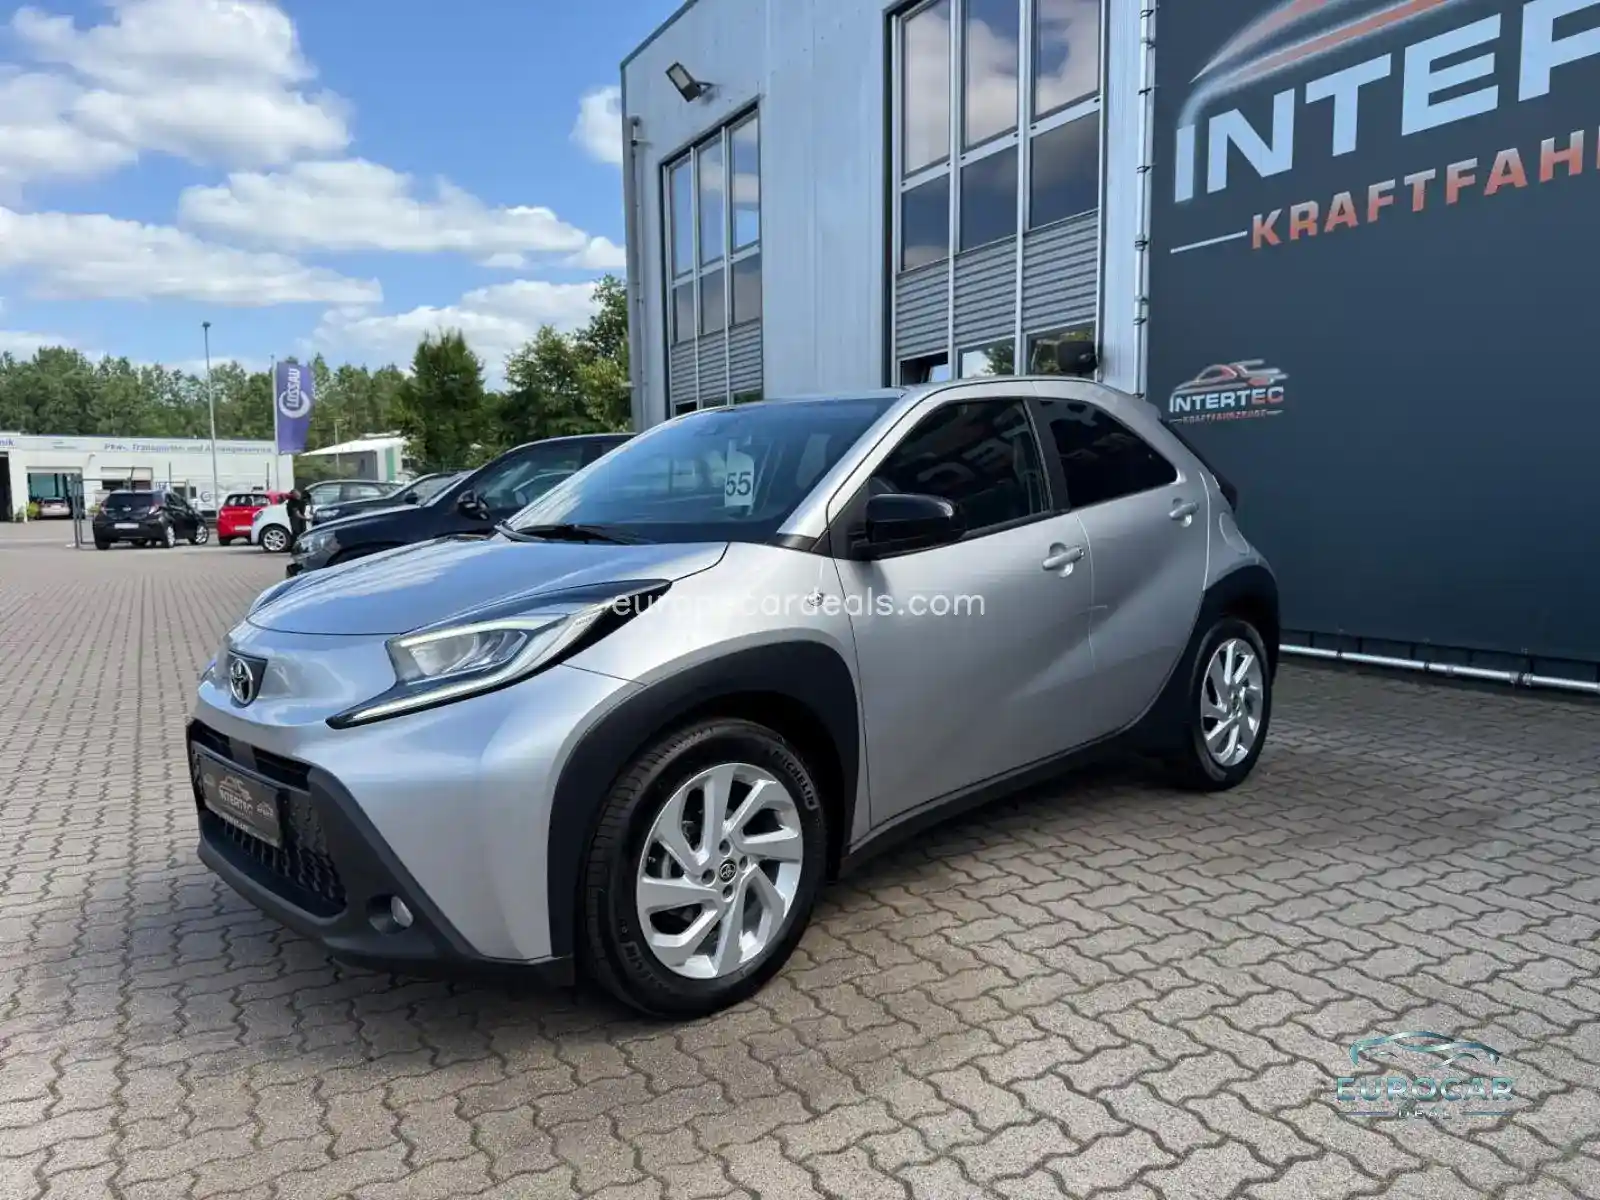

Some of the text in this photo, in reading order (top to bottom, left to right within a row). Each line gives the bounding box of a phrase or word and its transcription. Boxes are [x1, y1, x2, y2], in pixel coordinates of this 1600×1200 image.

[1252, 125, 1600, 249] KRAFTFAH
[1169, 386, 1284, 413] INTERTEC
[726, 471, 752, 497] 55
